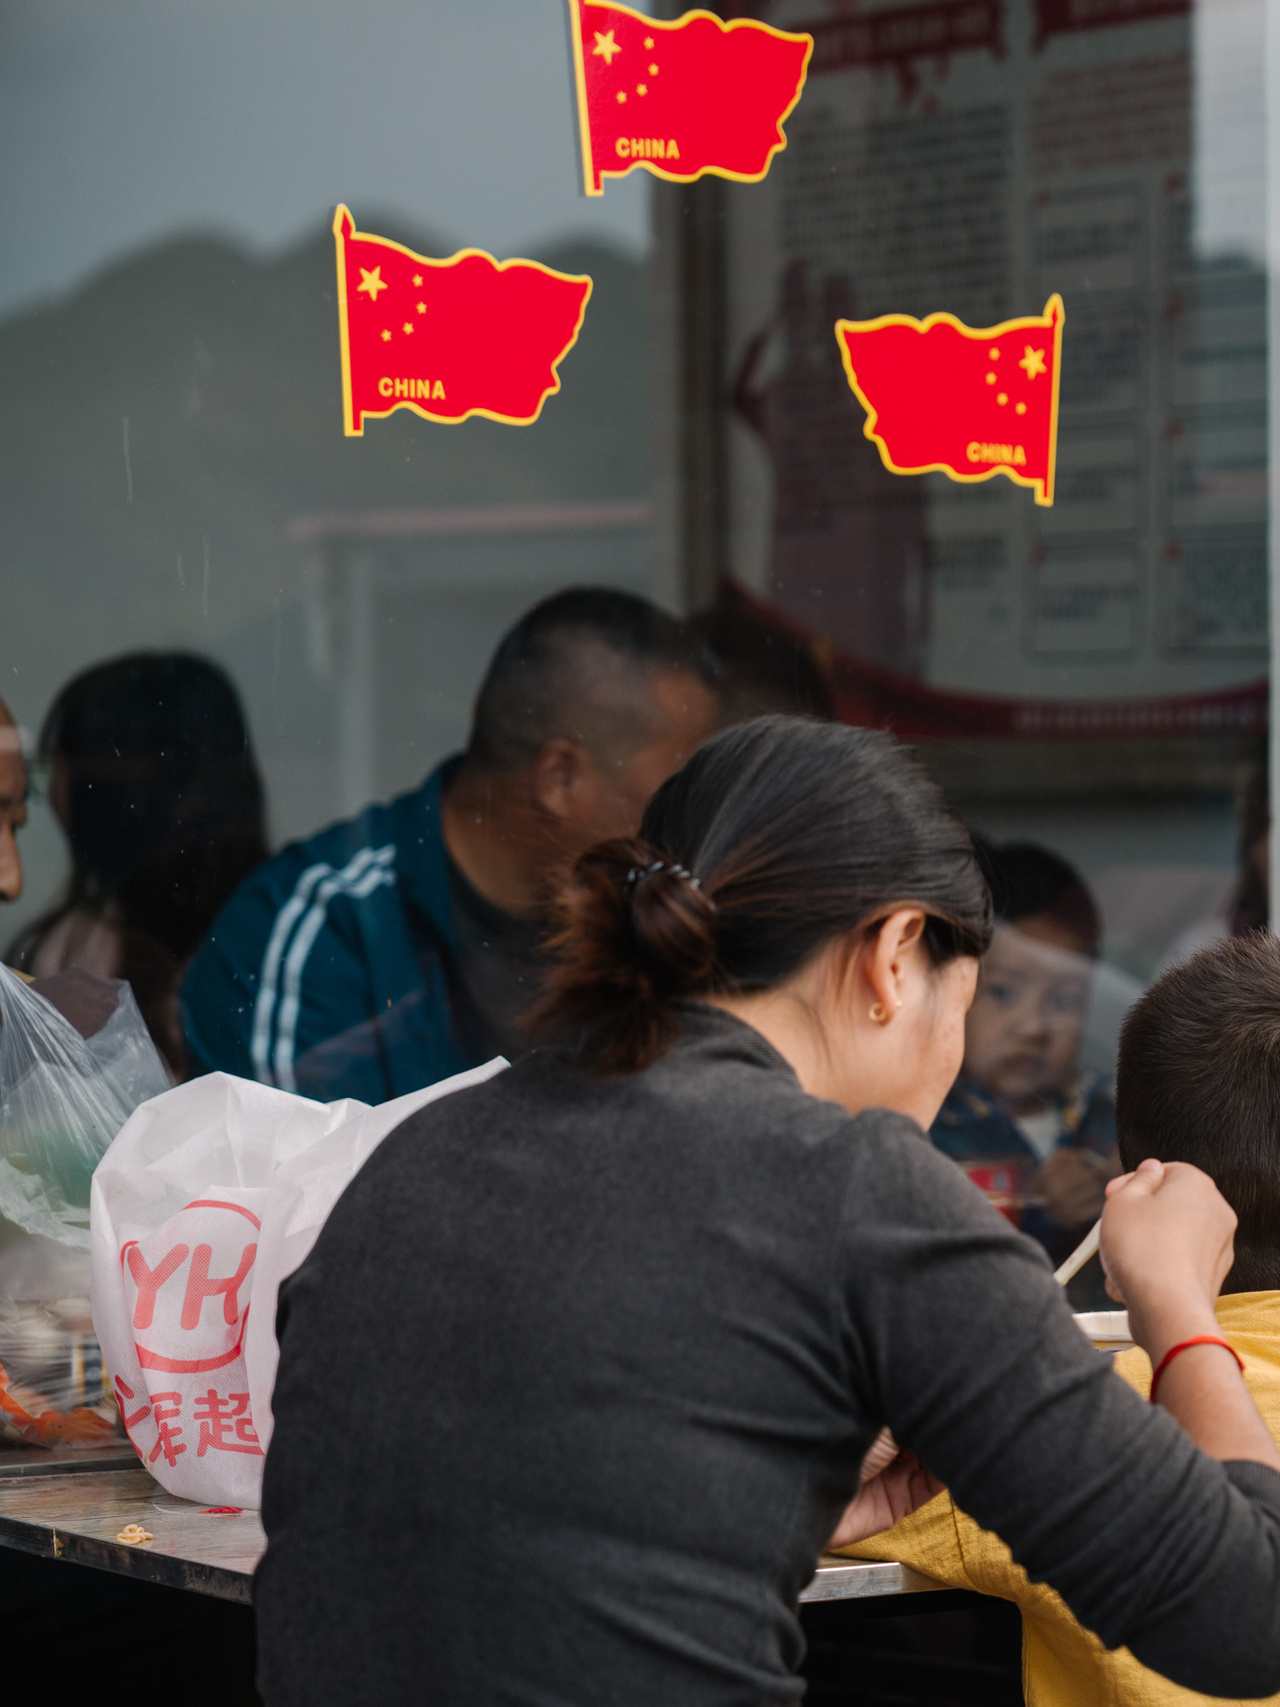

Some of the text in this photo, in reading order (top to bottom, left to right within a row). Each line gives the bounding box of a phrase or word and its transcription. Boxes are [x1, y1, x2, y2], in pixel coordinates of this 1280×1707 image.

[615, 137, 680, 159] CHINA
[378, 376, 446, 400] CHINA
[966, 441, 1027, 467] CHINA
[128, 1244, 258, 1330] YH
